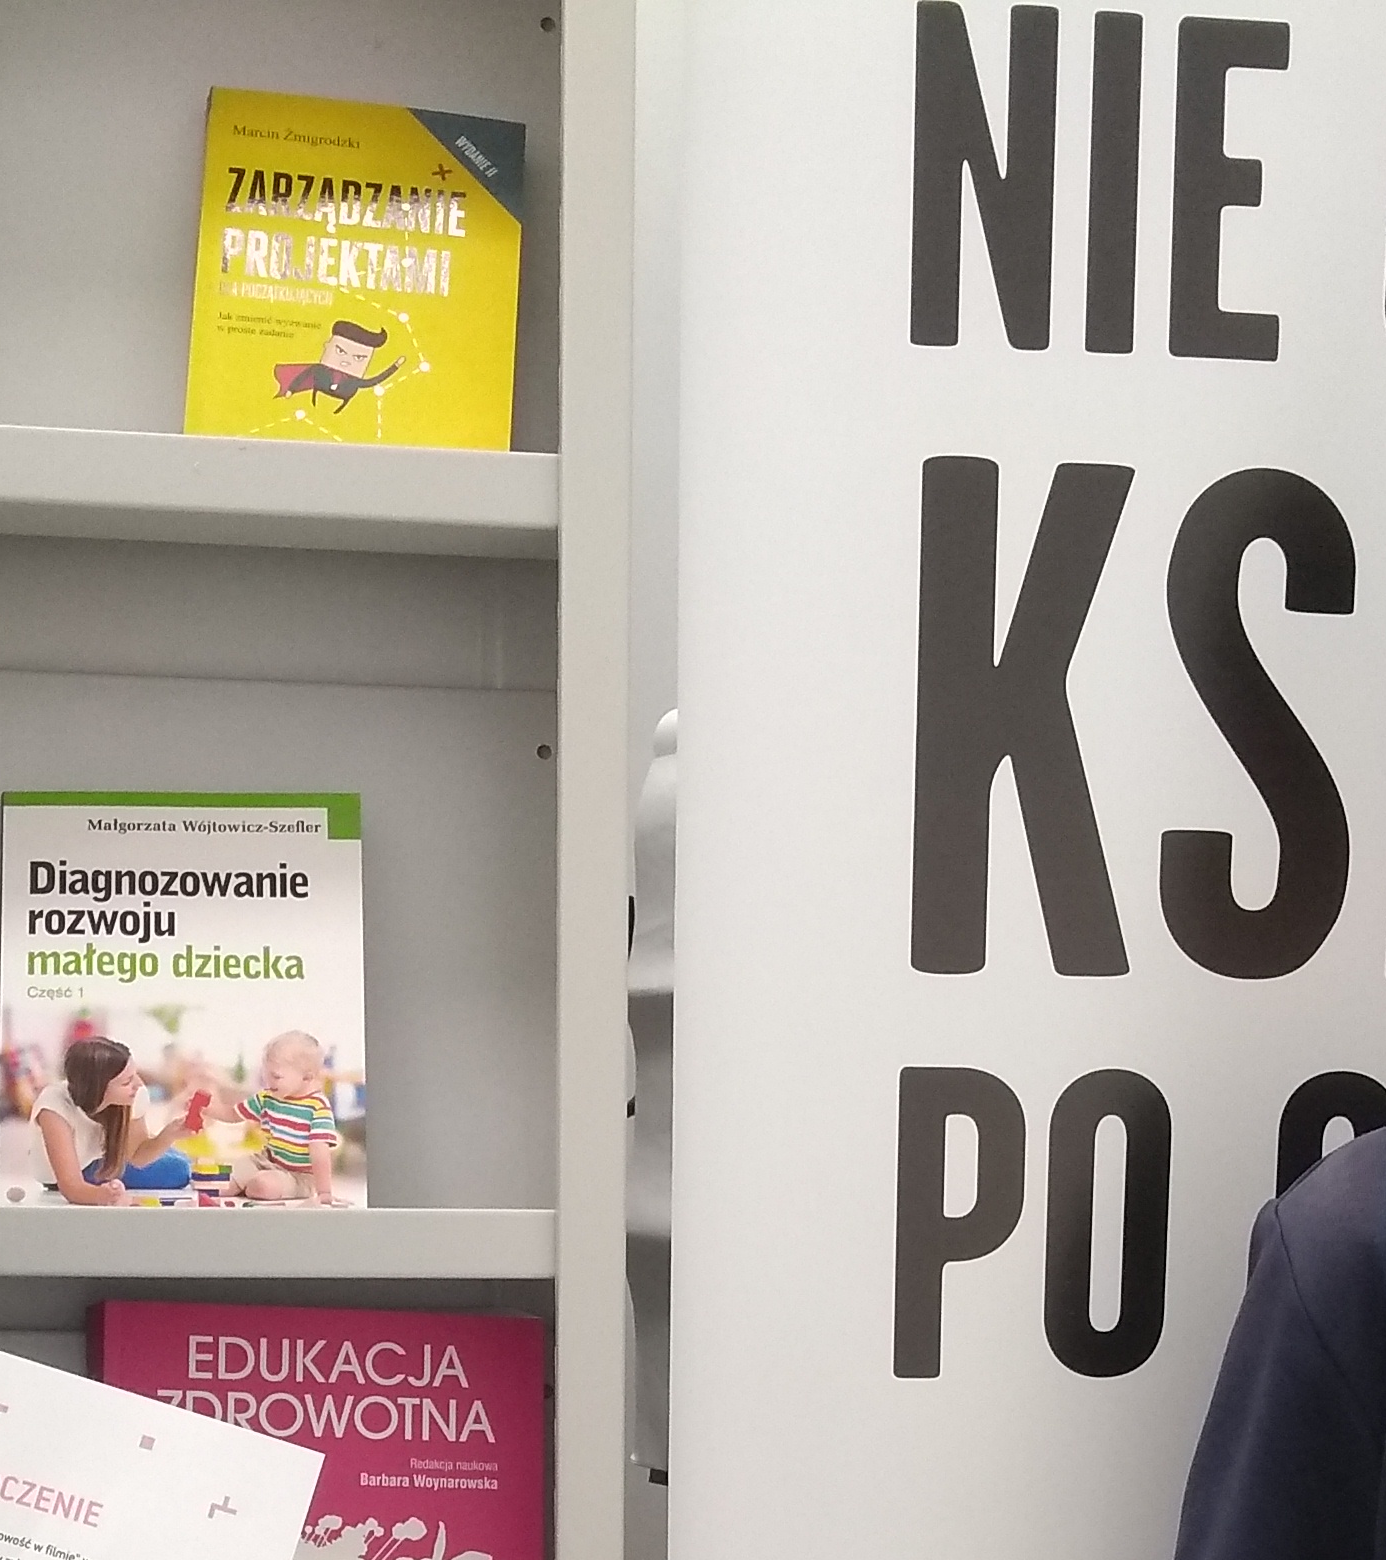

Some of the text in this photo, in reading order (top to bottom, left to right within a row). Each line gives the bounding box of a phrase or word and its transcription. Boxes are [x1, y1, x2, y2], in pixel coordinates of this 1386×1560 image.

[233, 125, 280, 140] Marcin
[910, 0, 1290, 361] NIE
[225, 167, 467, 237] ZARZĄDZANIE
[221, 226, 451, 297] PROJEKTAMI
[87, 818, 322, 836] Małgorzata Wójtowicz-Szefler
[29, 860, 309, 903] Diagnozowanie
[28, 901, 176, 944] rozwoju
[27, 942, 305, 983] małego dziecka
[27, 986, 84, 1000] Część 1
[893, 1066, 1171, 1380] PO
[188, 1335, 469, 1388] EDUKACJA
[359, 1472, 498, 1491] Barbara Woynarowska
[409, 1458, 498, 1472] Redakcja naukowa
[33, 1542, 45, 1554] w
